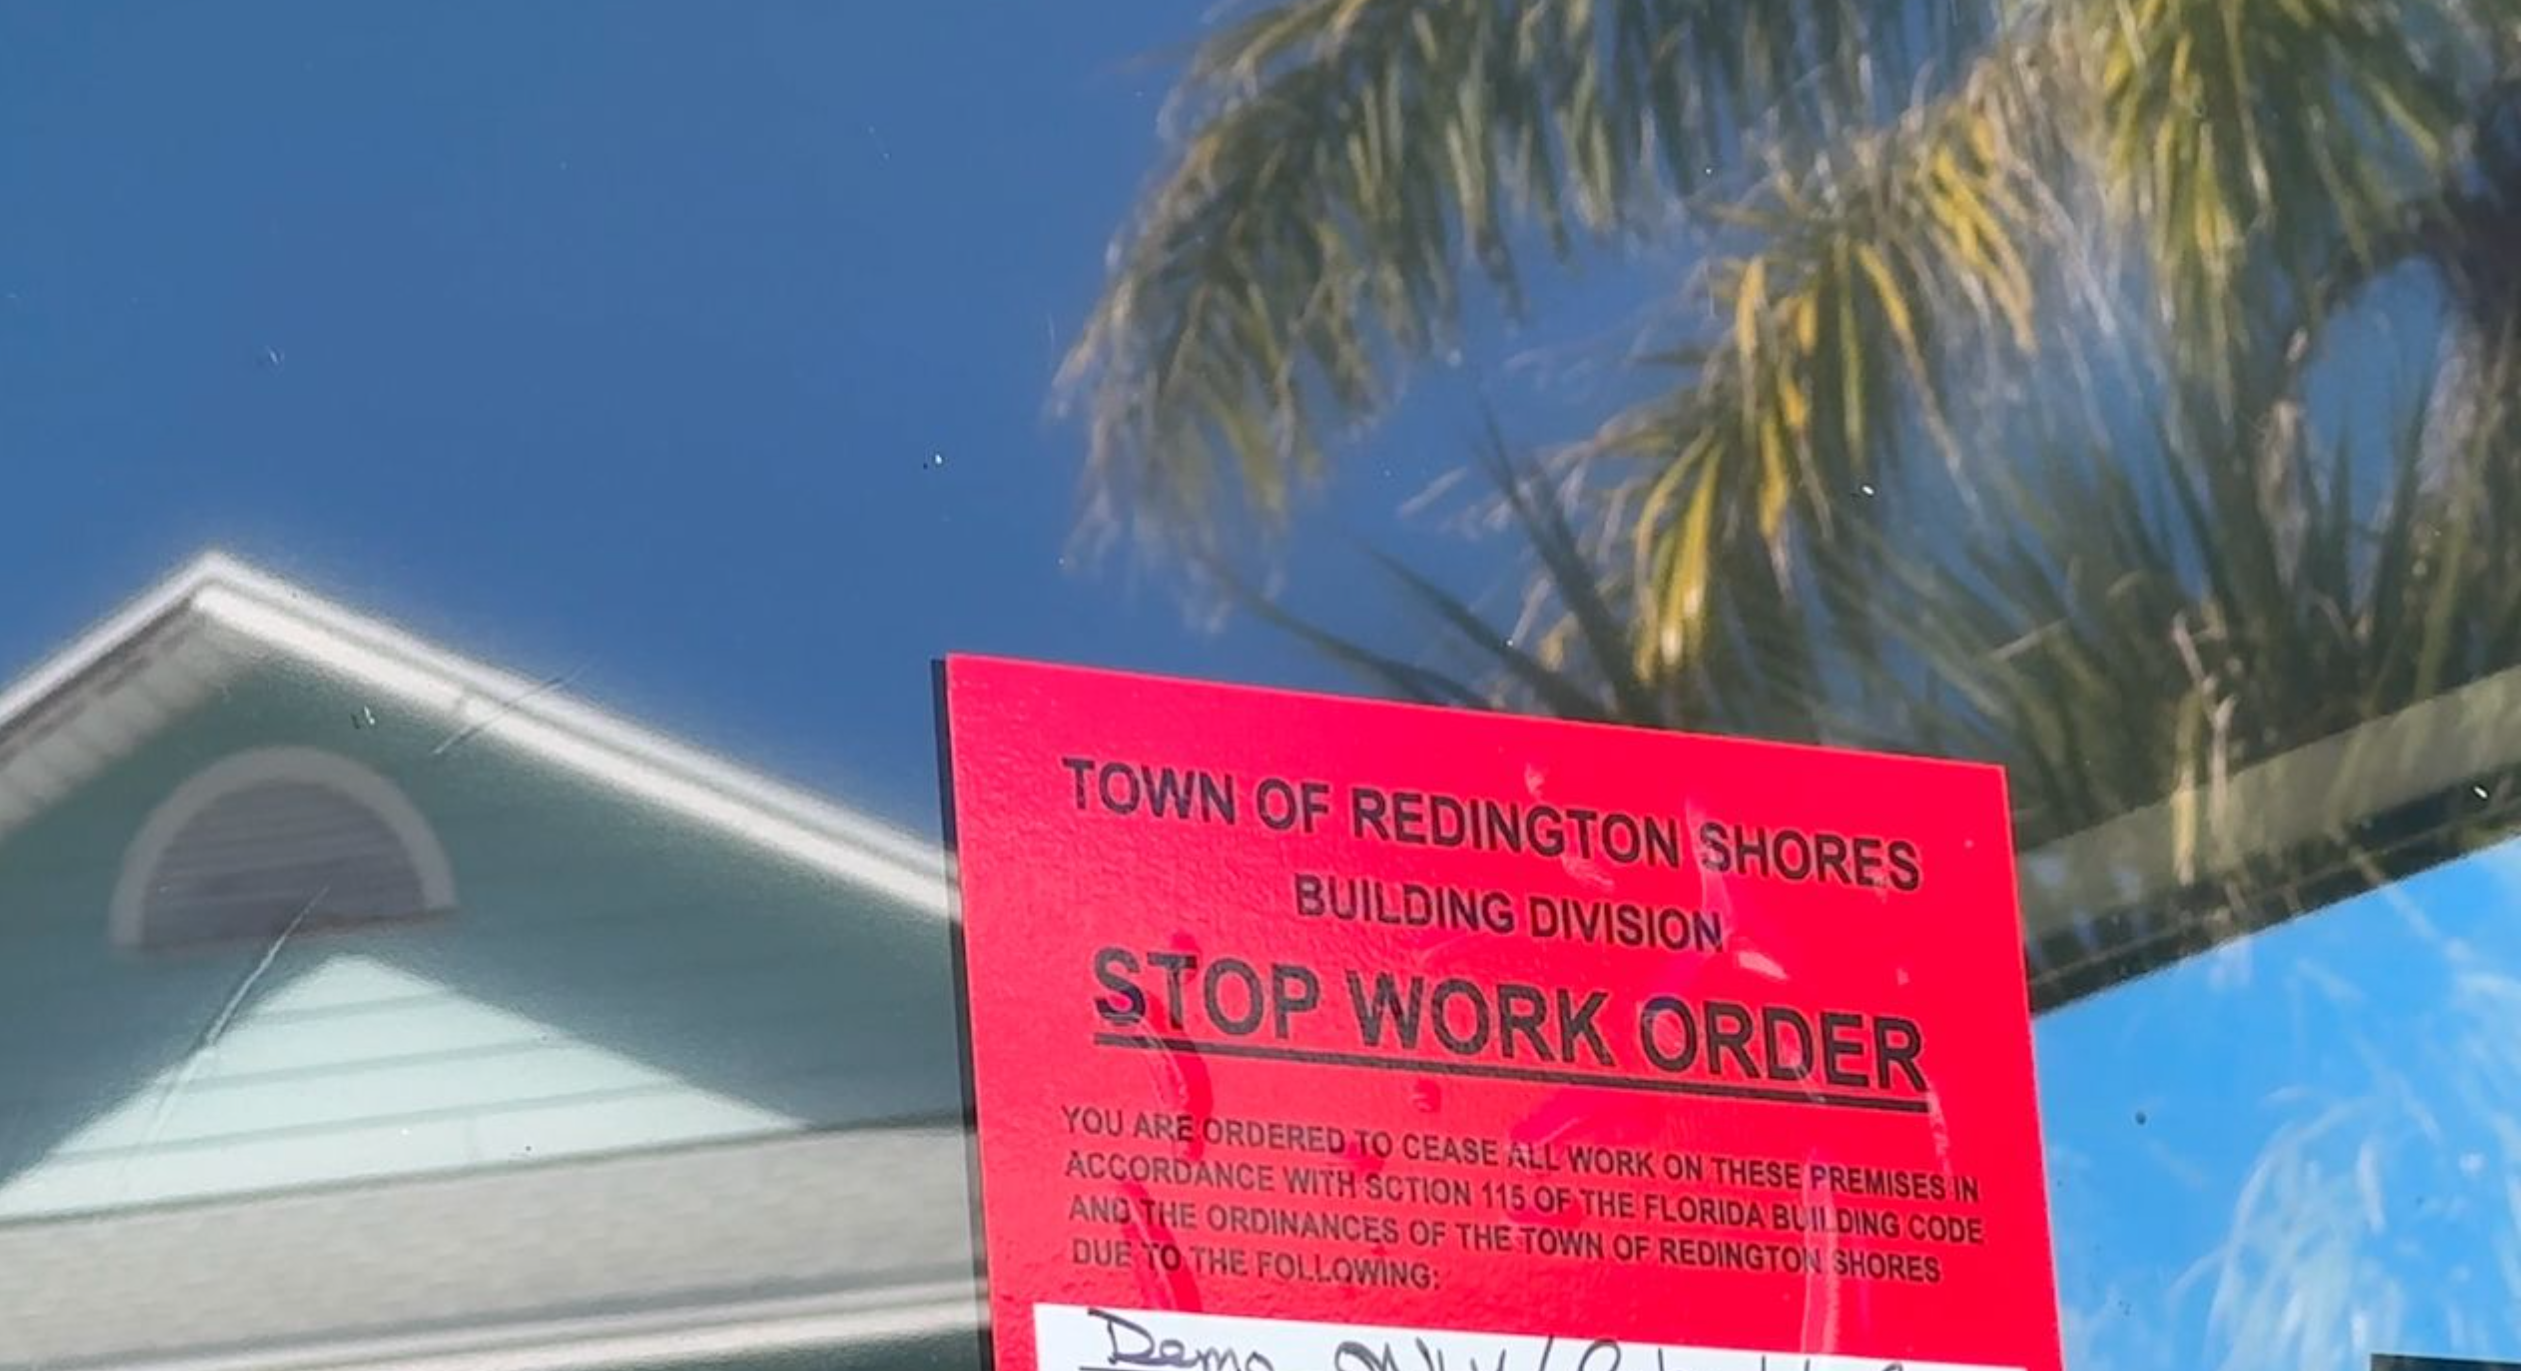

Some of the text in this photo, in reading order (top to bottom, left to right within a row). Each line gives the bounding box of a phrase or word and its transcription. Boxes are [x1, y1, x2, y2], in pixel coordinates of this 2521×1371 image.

[1062, 757, 1920, 891] TOWN OF REDINGTON SHORES
[1294, 873, 1723, 953] BUILDING DIVISION
[1094, 947, 1928, 1091] STOP WORK ORDER
[1062, 1105, 1979, 1203] YOU ARE ORDERED TO CEASE ALL WORK ON THESE PREMISES IN
[1066, 1151, 1983, 1244] ACCORDANCE WITH SCTION 115 OF THE FLORIDA BUILDING CODE
[1069, 1195, 1941, 1283] AND THE ORDINANCES OF THE TOWN OF REDINGTON SHORES
[1073, 1238, 1441, 1290] DUE TO THE FOLLOWING:
